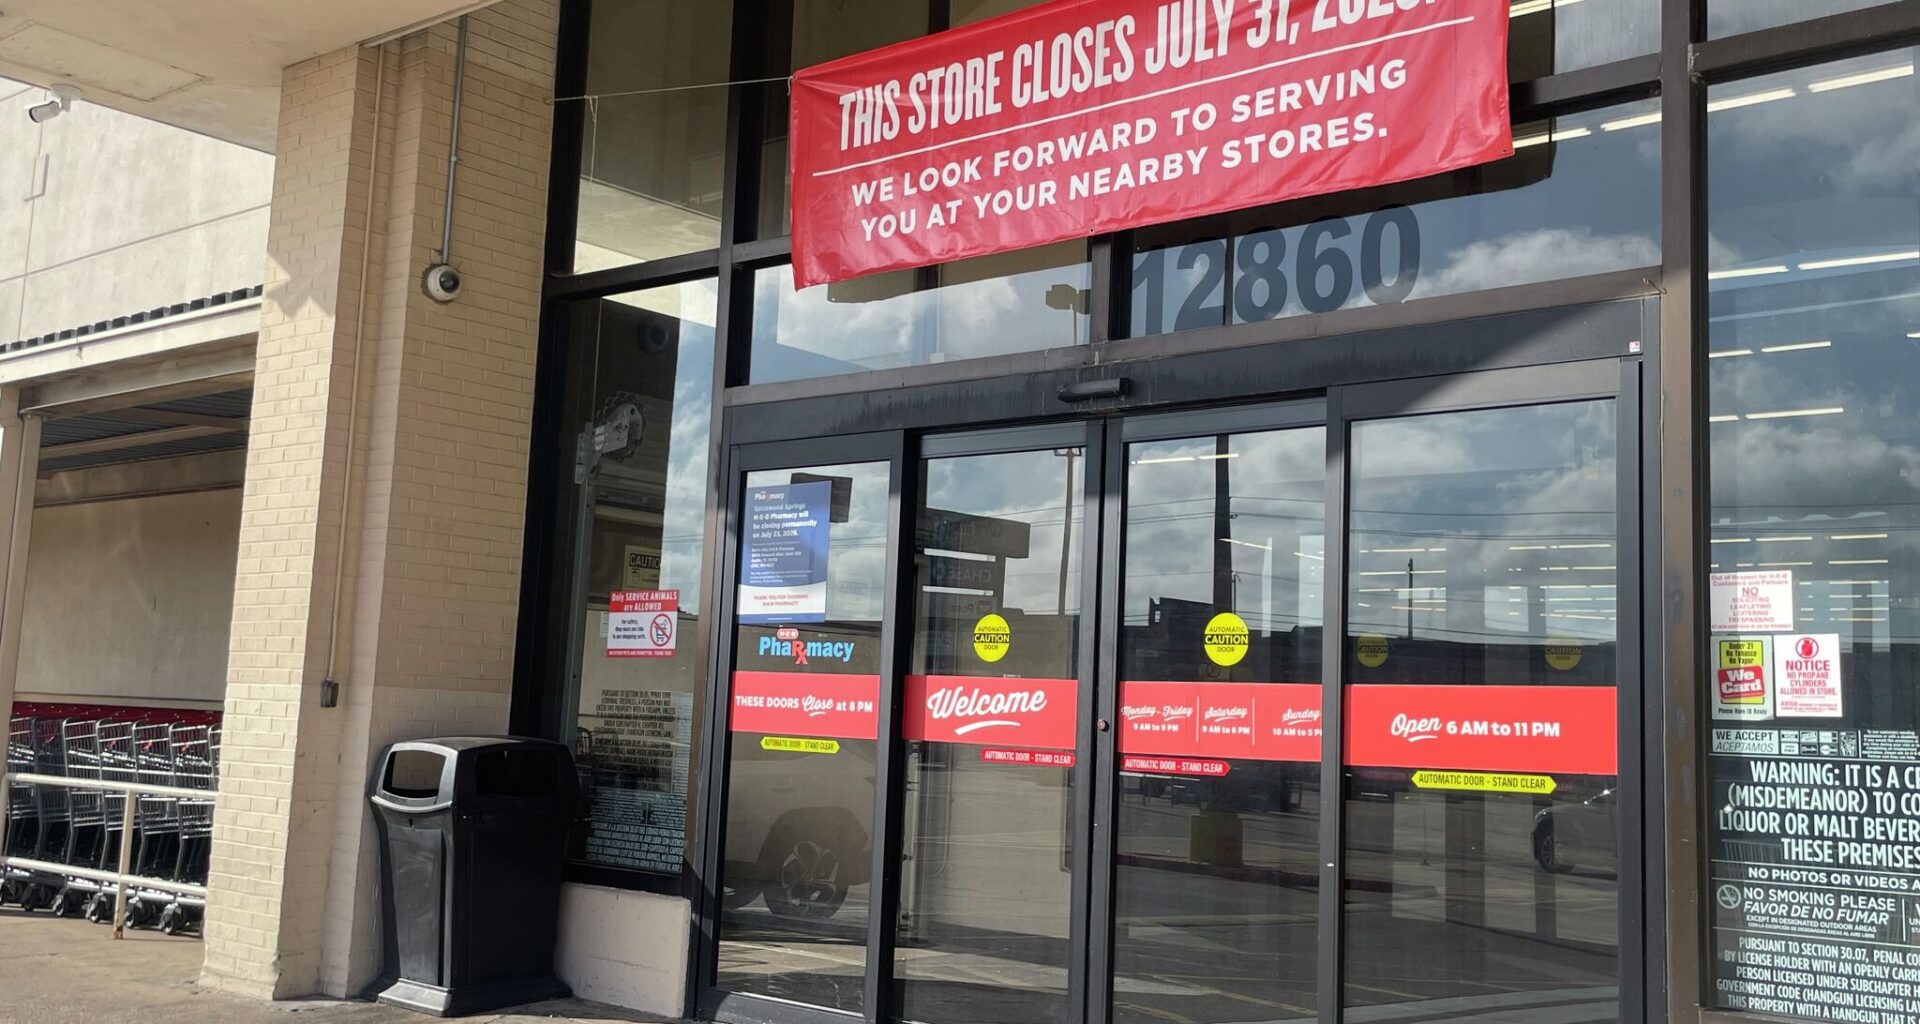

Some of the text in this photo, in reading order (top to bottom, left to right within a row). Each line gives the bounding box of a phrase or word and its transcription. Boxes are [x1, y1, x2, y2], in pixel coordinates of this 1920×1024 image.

[839, 79, 900, 151] THIS
[908, 51, 1004, 134] STORE
[1011, 14, 1135, 108] CLOSES
[1144, 0, 1235, 74] JULY
[851, 59, 1406, 207] WE LOOK FORWARD TO SERVING
[861, 112, 1388, 242] YOU AT YOUR NEARBY STORES.
[1131, 204, 1421, 336] 12860
[770, 510, 809, 520] Pharmacy will
[781, 520, 817, 528] permanently
[625, 591, 650, 601] SERVICE
[650, 591, 677, 601] ANIMALS
[1742, 587, 1759, 595] NO
[634, 602, 662, 611] ALLOWED
[974, 634, 1009, 643] CAUTION
[1205, 634, 1248, 645] CAUTION
[1785, 660, 1830, 671] NOTICE
[1727, 669, 1755, 682] We
[1798, 671, 1829, 679] PROPANE
[1721, 679, 1763, 694] Card
[736, 694, 873, 712] THESE DOORS Close at 8 PM
[926, 686, 1047, 719] Welcome
[1121, 705, 1193, 718] Monday Friday
[1205, 706, 1248, 720] Saturday
[1282, 708, 1321, 722] Sunday
[1139, 723, 1151, 731] AM
[1152, 723, 1160, 731] to
[1272, 728, 1282, 736] 10
[1283, 728, 1296, 736] AM
[1391, 713, 1560, 737] Open 6 AM to 11 PM
[1716, 730, 1773, 741] WE ACCEPT
[1715, 741, 1774, 753] ACEPTAMOS
[984, 750, 1071, 764] AUTOMATIC DOOR STAND CLEAR
[1125, 759, 1223, 773] AUTOMATIC DOOR STAND CLEAR
[1419, 774, 1462, 785] AUTOMATIC
[1464, 776, 1485, 786] DOOR
[1492, 777, 1518, 788] STAND
[1520, 778, 1546, 789] CLEAR
[1750, 760, 1900, 789] WARNING: IT IS A
[1728, 782, 1868, 814] (MISDEMEANOR)
[1872, 791, 1896, 814] TO
[1719, 809, 1781, 834] LIQUOR
[1784, 812, 1809, 836] OR
[1813, 814, 1859, 838] MALT
[1780, 838, 1834, 863] THESE
[1748, 867, 1768, 879] NO
[1772, 869, 1828, 884] PHOTOS
[1830, 873, 1851, 886] OR
[1854, 874, 1908, 890] VIDEOS
[1743, 886, 1764, 900] NO
[1768, 889, 1835, 906] SMOKING
[1840, 894, 1896, 912] PLEASE
[1743, 901, 1889, 925] FAVOR DE NO FUMAR
[1746, 914, 1770, 923] EXCEPT
[1778, 917, 1819, 927] DESIGNATED
[1820, 921, 1853, 931] OUTDOOR
[1854, 924, 1877, 933] AREAS
[1738, 936, 1905, 965] PURSUANT TO SECTION 30.07, PENAL
[1724, 950, 1736, 962] BY
[1737, 951, 1773, 967] LICENSE
[1774, 954, 1810, 971] HOLDER
[1811, 958, 1836, 974] WITH
[1838, 961, 1852, 975] AN
[1853, 963, 1890, 979] OPENLY
[1736, 965, 1771, 982] PERSON
[1772, 969, 1815, 986] LICENSED
[1816, 974, 1848, 990] UNDER
[1850, 978, 1911, 997] SUBCHAPTER
[1716, 978, 1904, 1012] GOVERNMENT CODE (HANDGUN LICENSING
[1727, 994, 1747, 1008] THIS
[1748, 996, 1795, 1014] PROPERTY
[1796, 1001, 1820, 1017] WITH
[1822, 1005, 1830, 1019] A
[1831, 1006, 1879, 1024] HANDGUN
